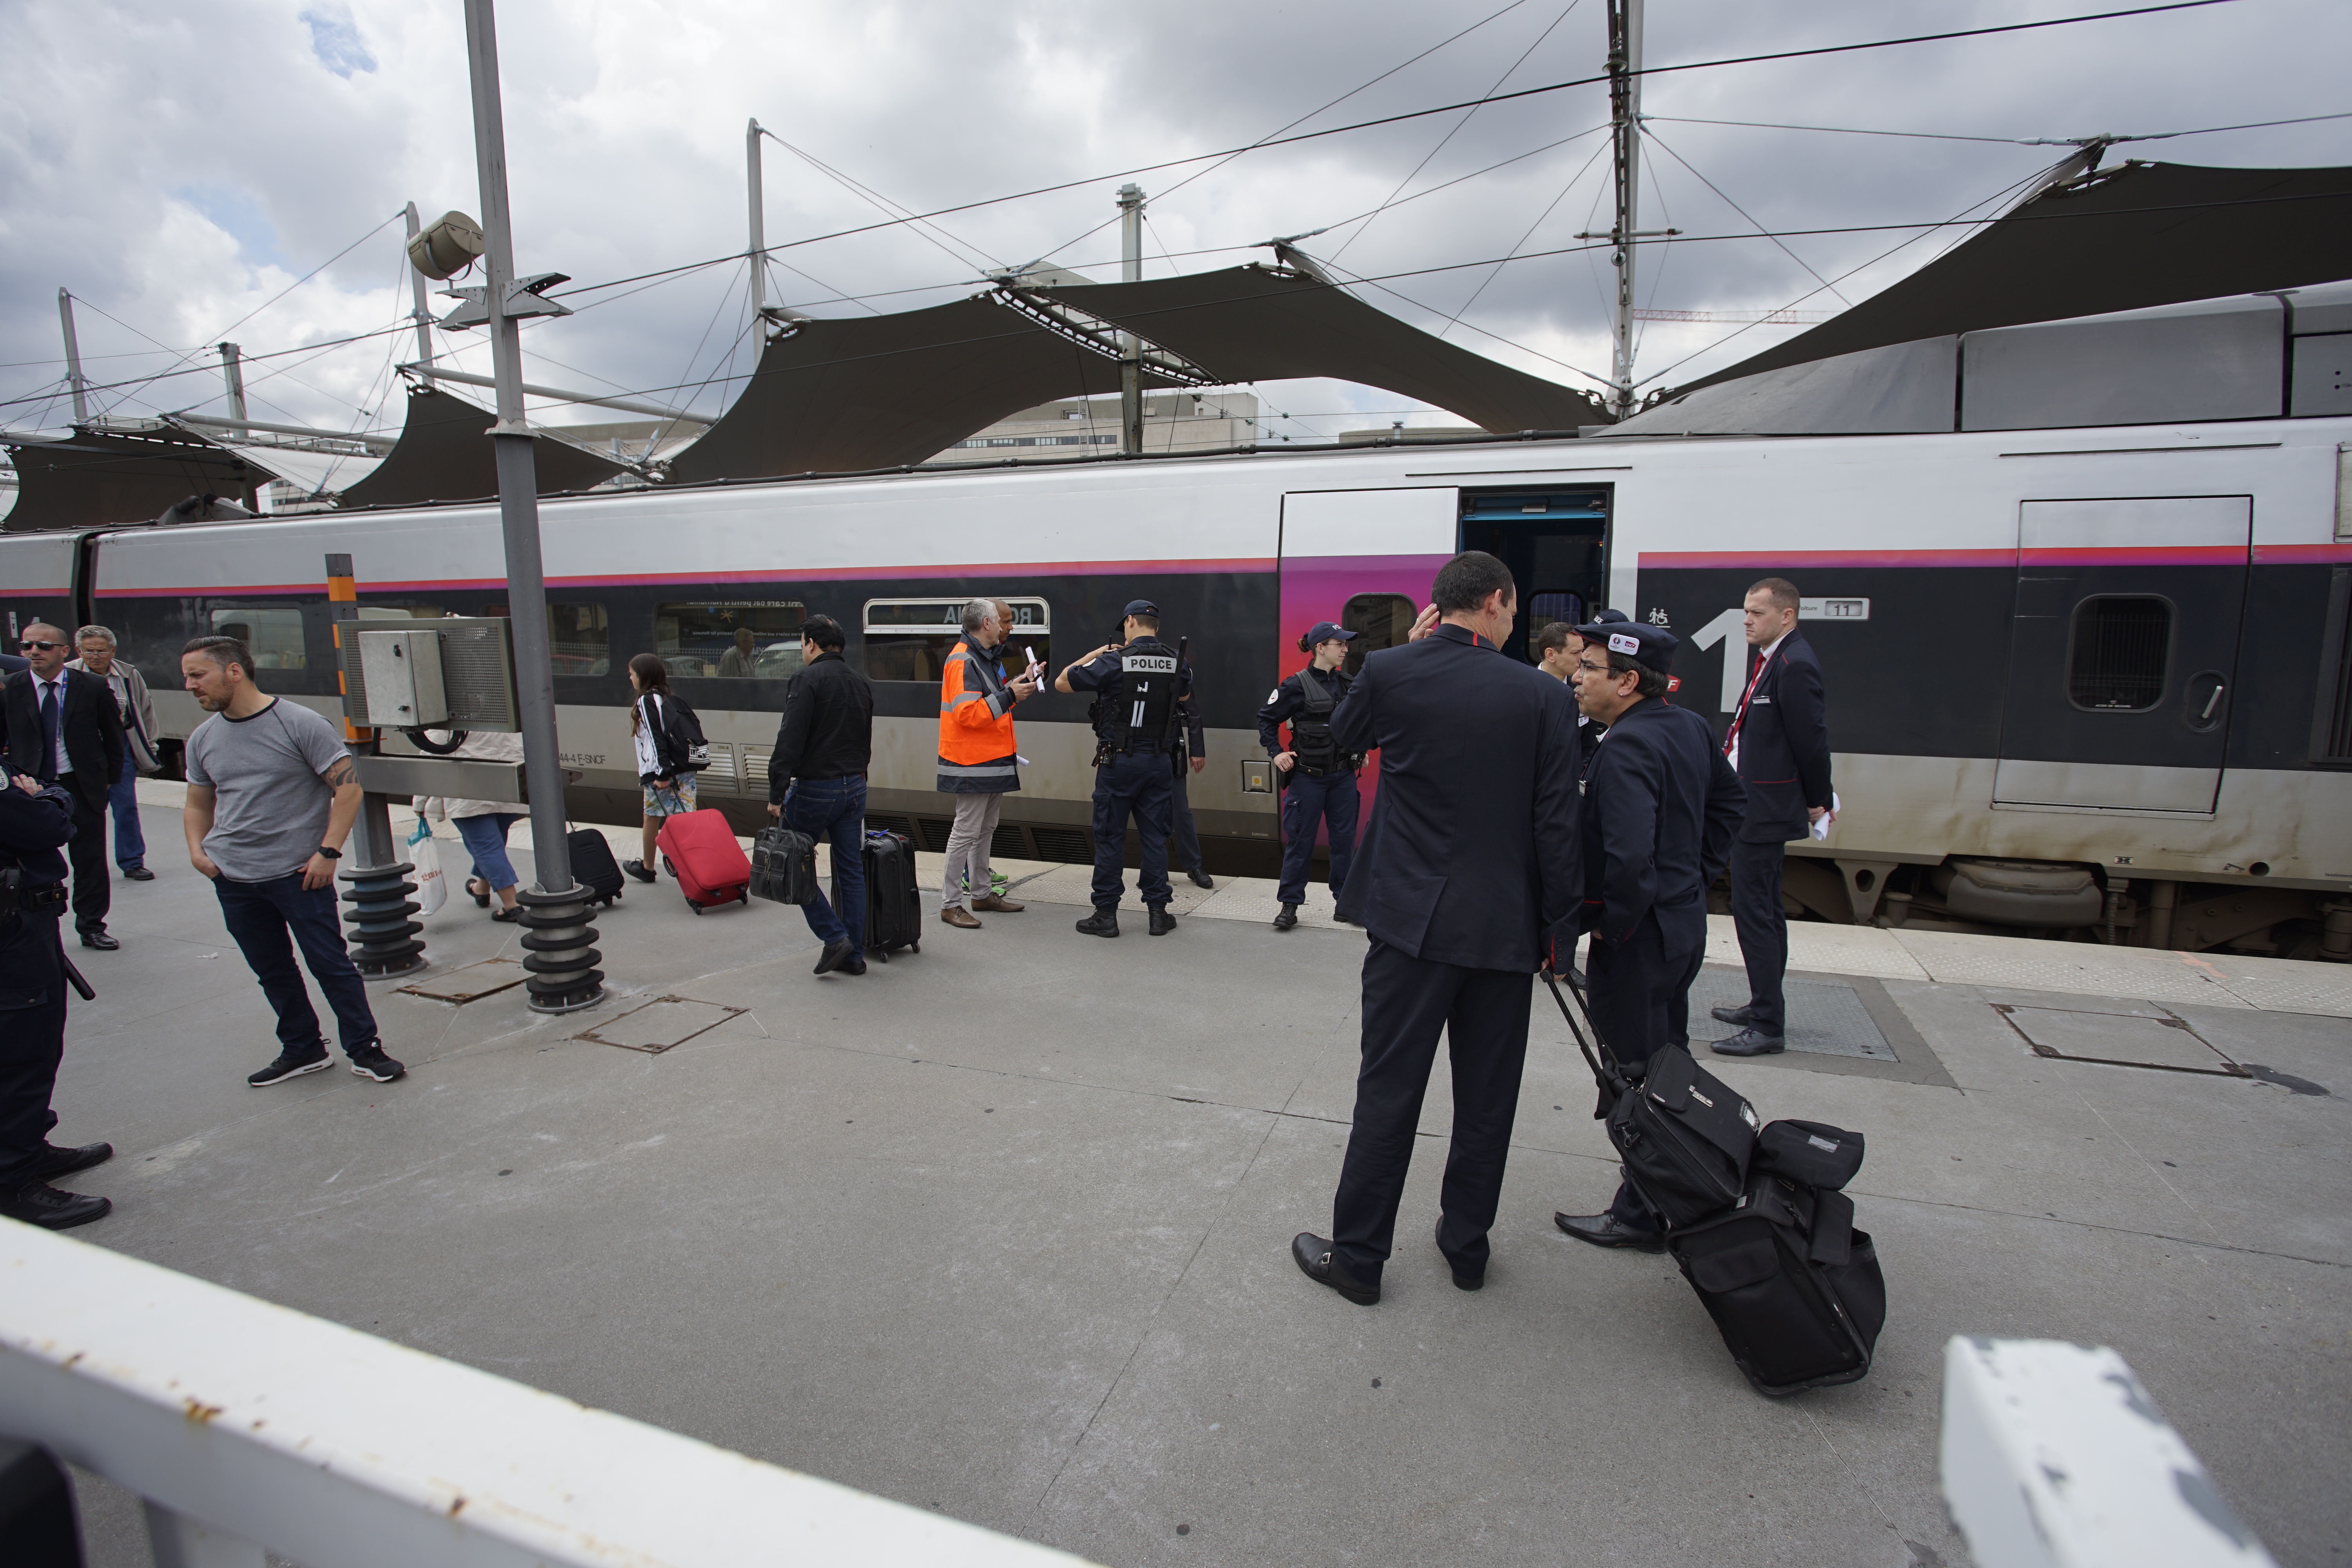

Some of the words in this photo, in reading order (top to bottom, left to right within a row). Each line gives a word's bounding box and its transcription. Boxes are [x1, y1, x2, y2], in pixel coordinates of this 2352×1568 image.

[1834, 604, 1849, 616] 11
[1131, 659, 1172, 670] POLICE
[577, 754, 606, 765] F-SNCF
